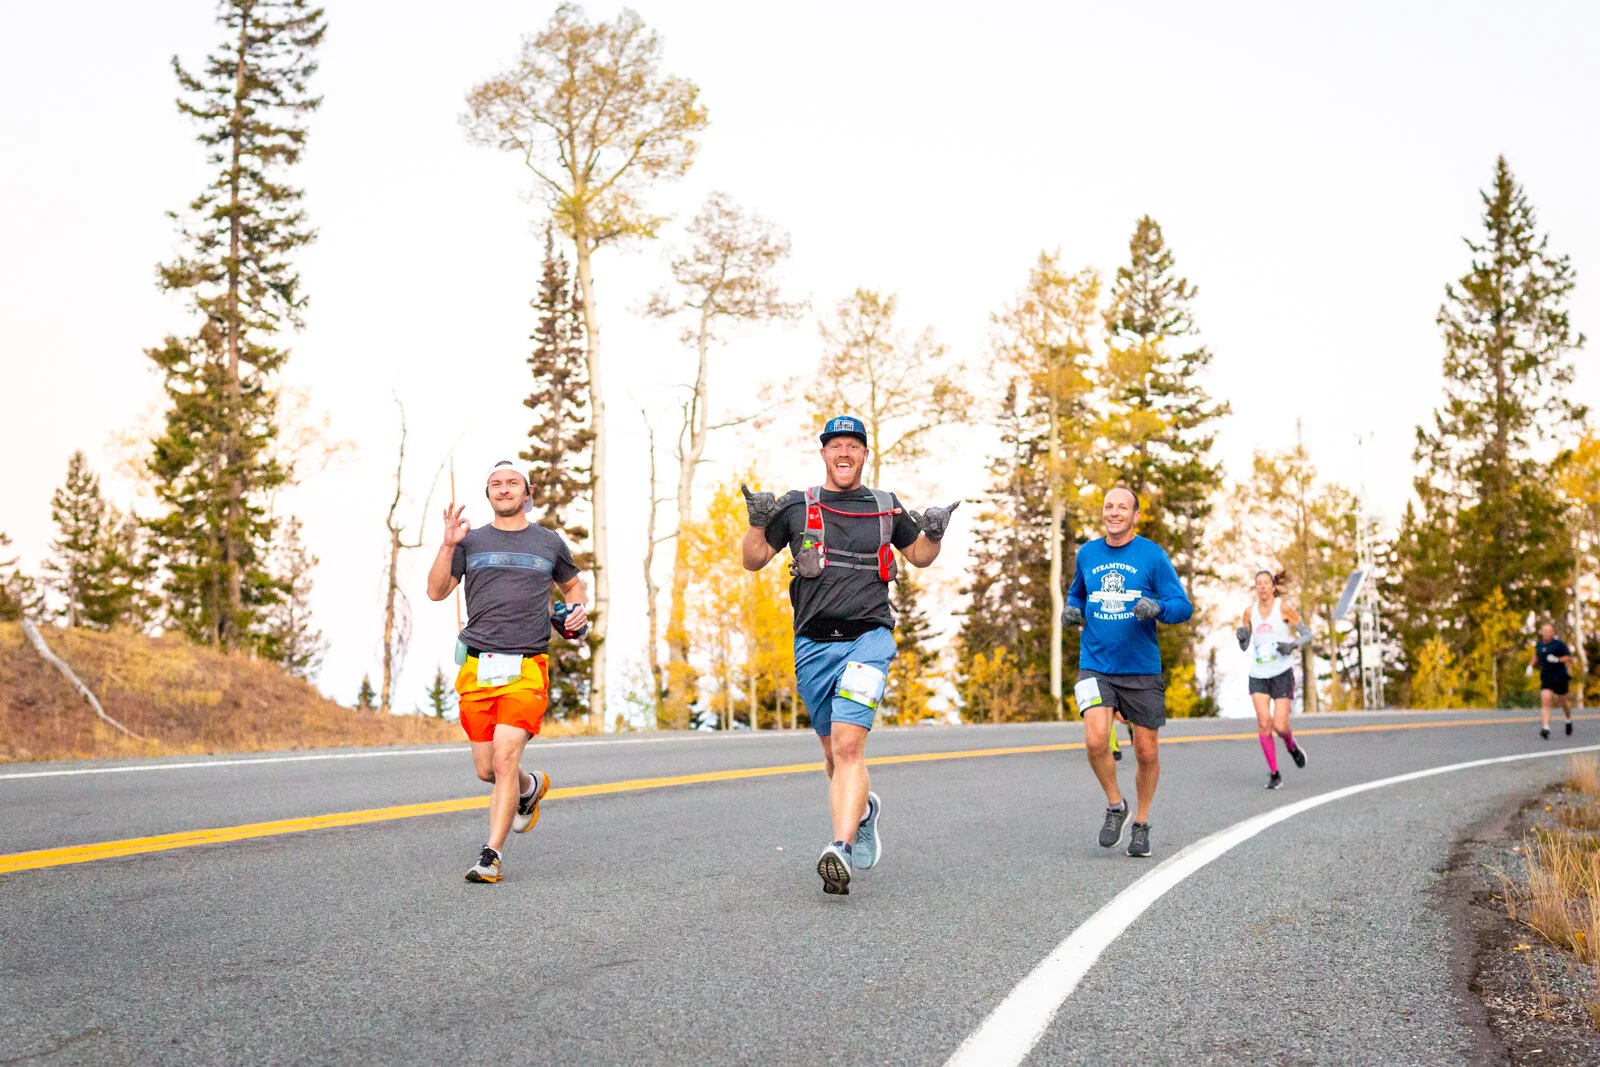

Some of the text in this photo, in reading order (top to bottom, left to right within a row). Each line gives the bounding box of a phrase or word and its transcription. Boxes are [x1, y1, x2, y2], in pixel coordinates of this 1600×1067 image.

[489, 554, 543, 568] BROOKS
[1092, 563, 1138, 575] STEAMTOWN
[1093, 611, 1135, 620] MARATHON
